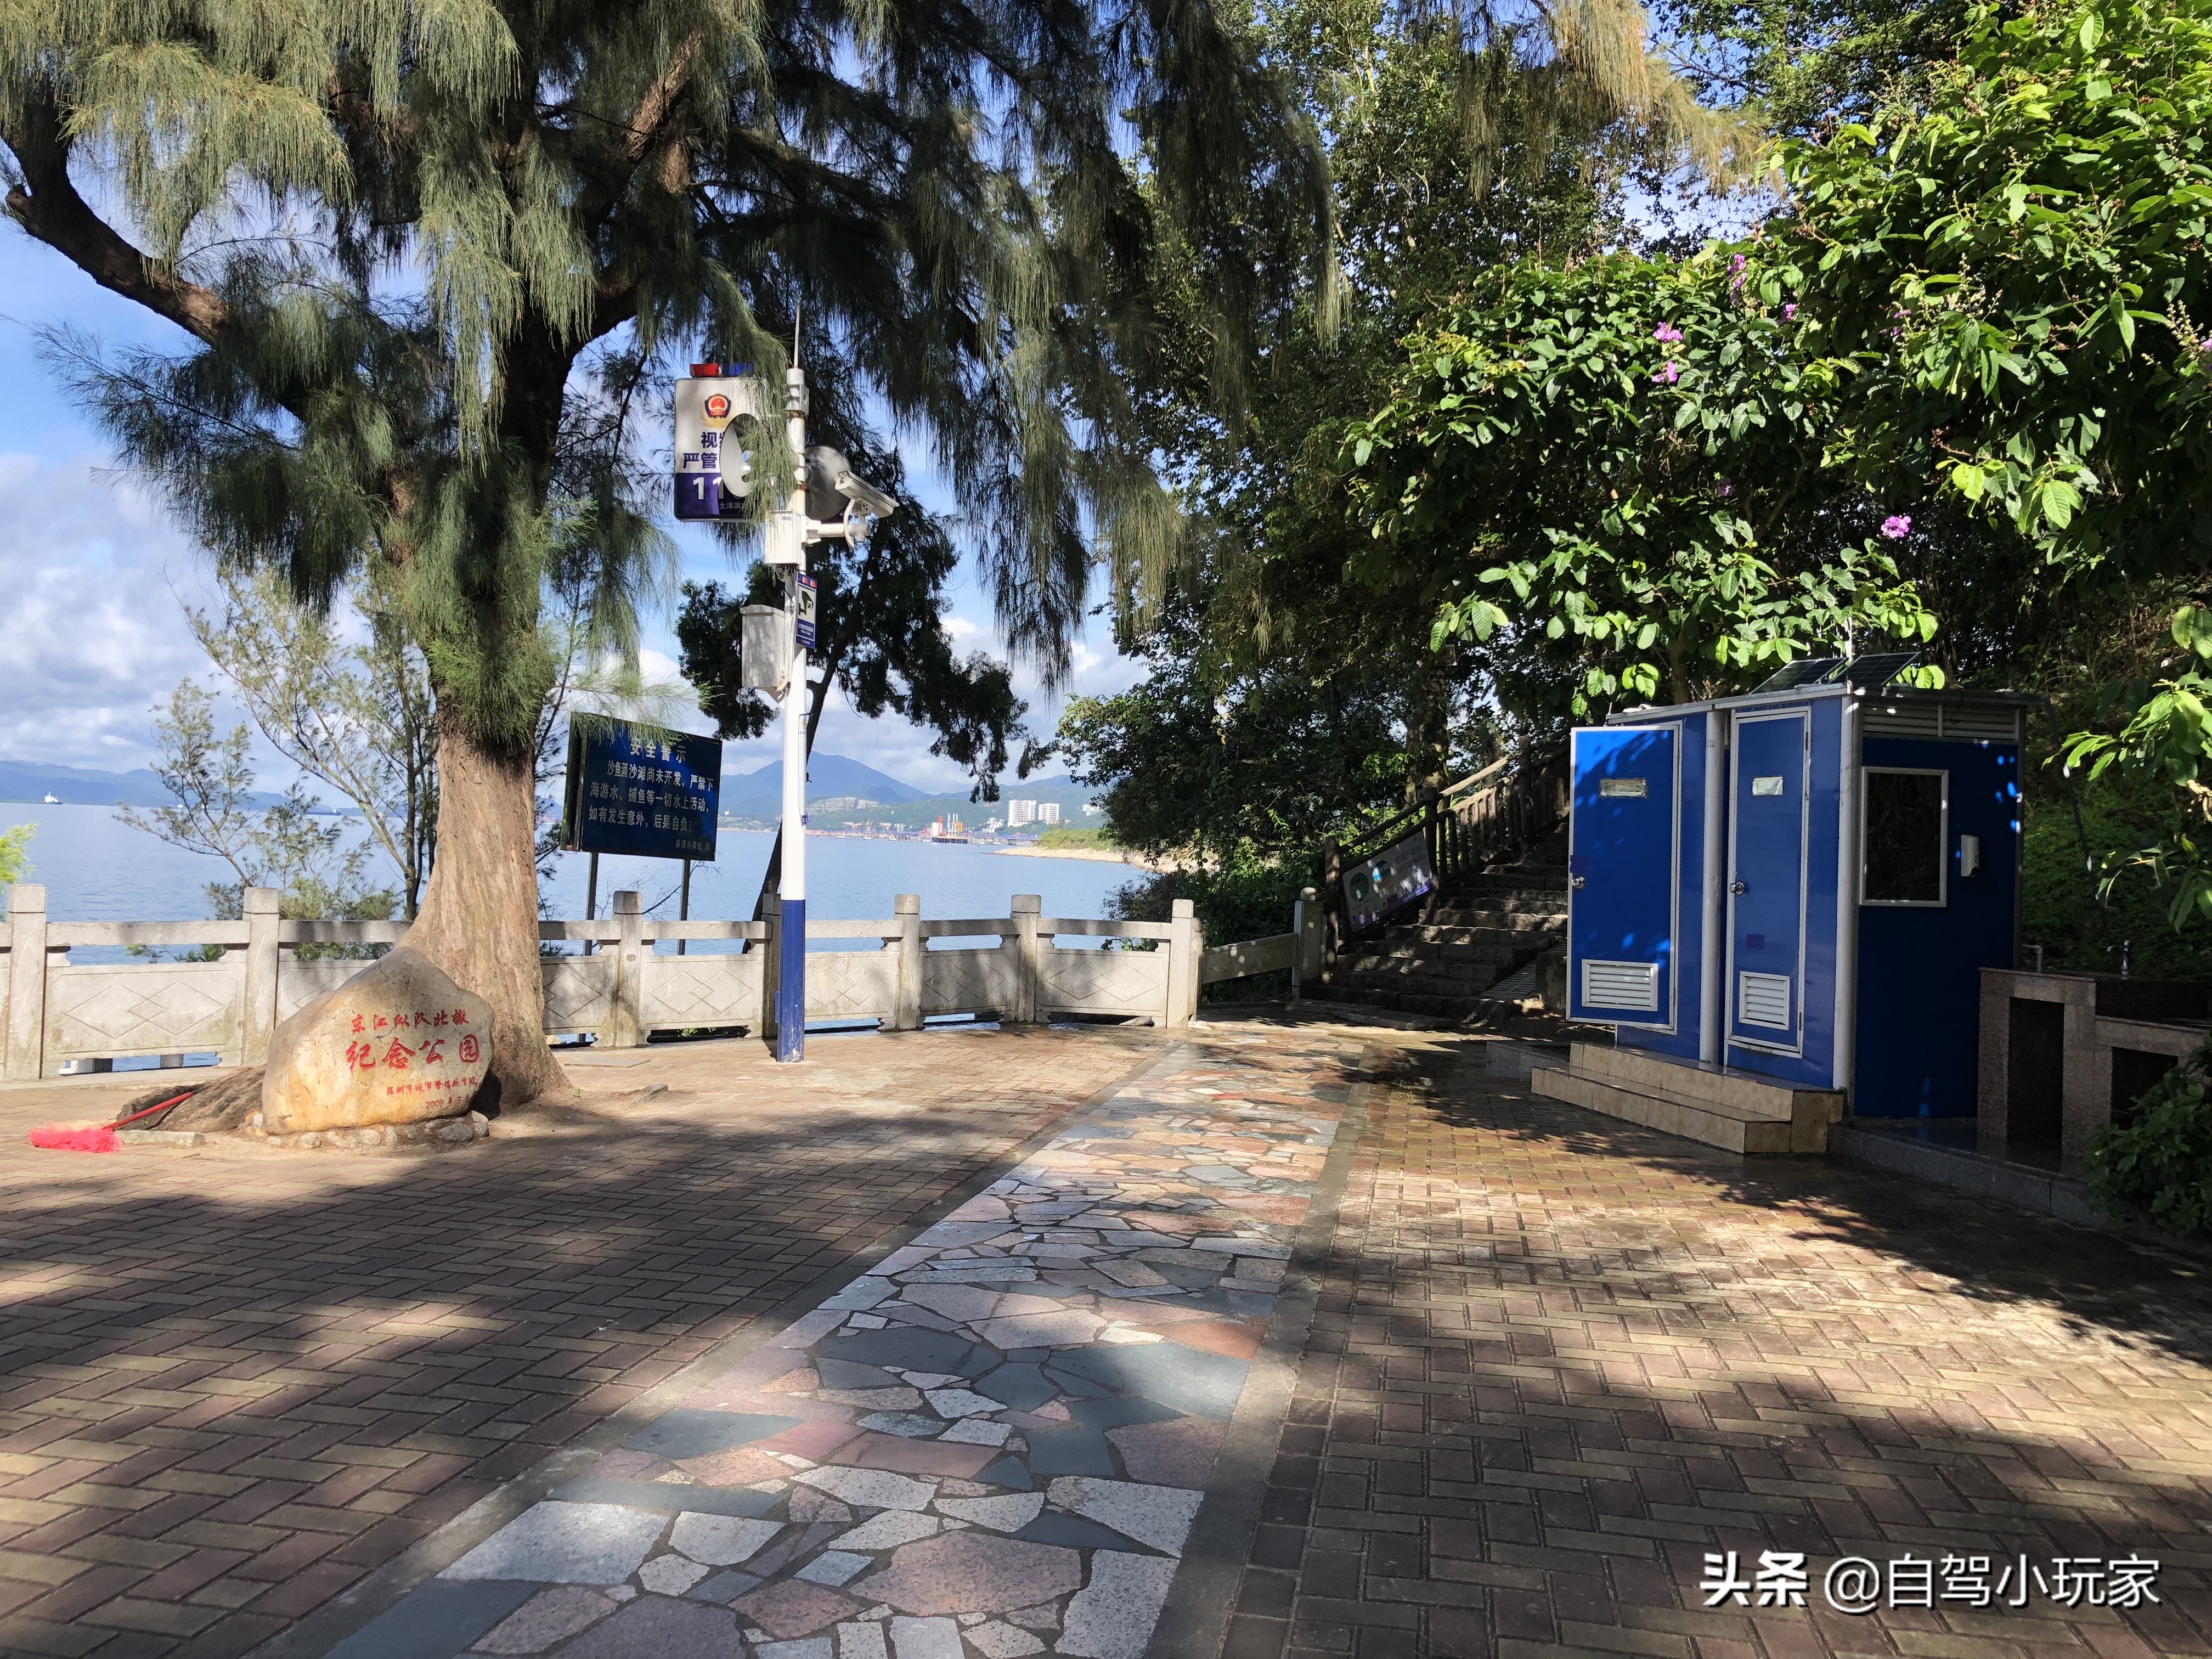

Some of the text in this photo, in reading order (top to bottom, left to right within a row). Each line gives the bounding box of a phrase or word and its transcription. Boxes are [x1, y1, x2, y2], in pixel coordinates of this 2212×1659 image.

[682, 452, 718, 469] 严管
[346, 1034, 479, 1071] 纪念公园
